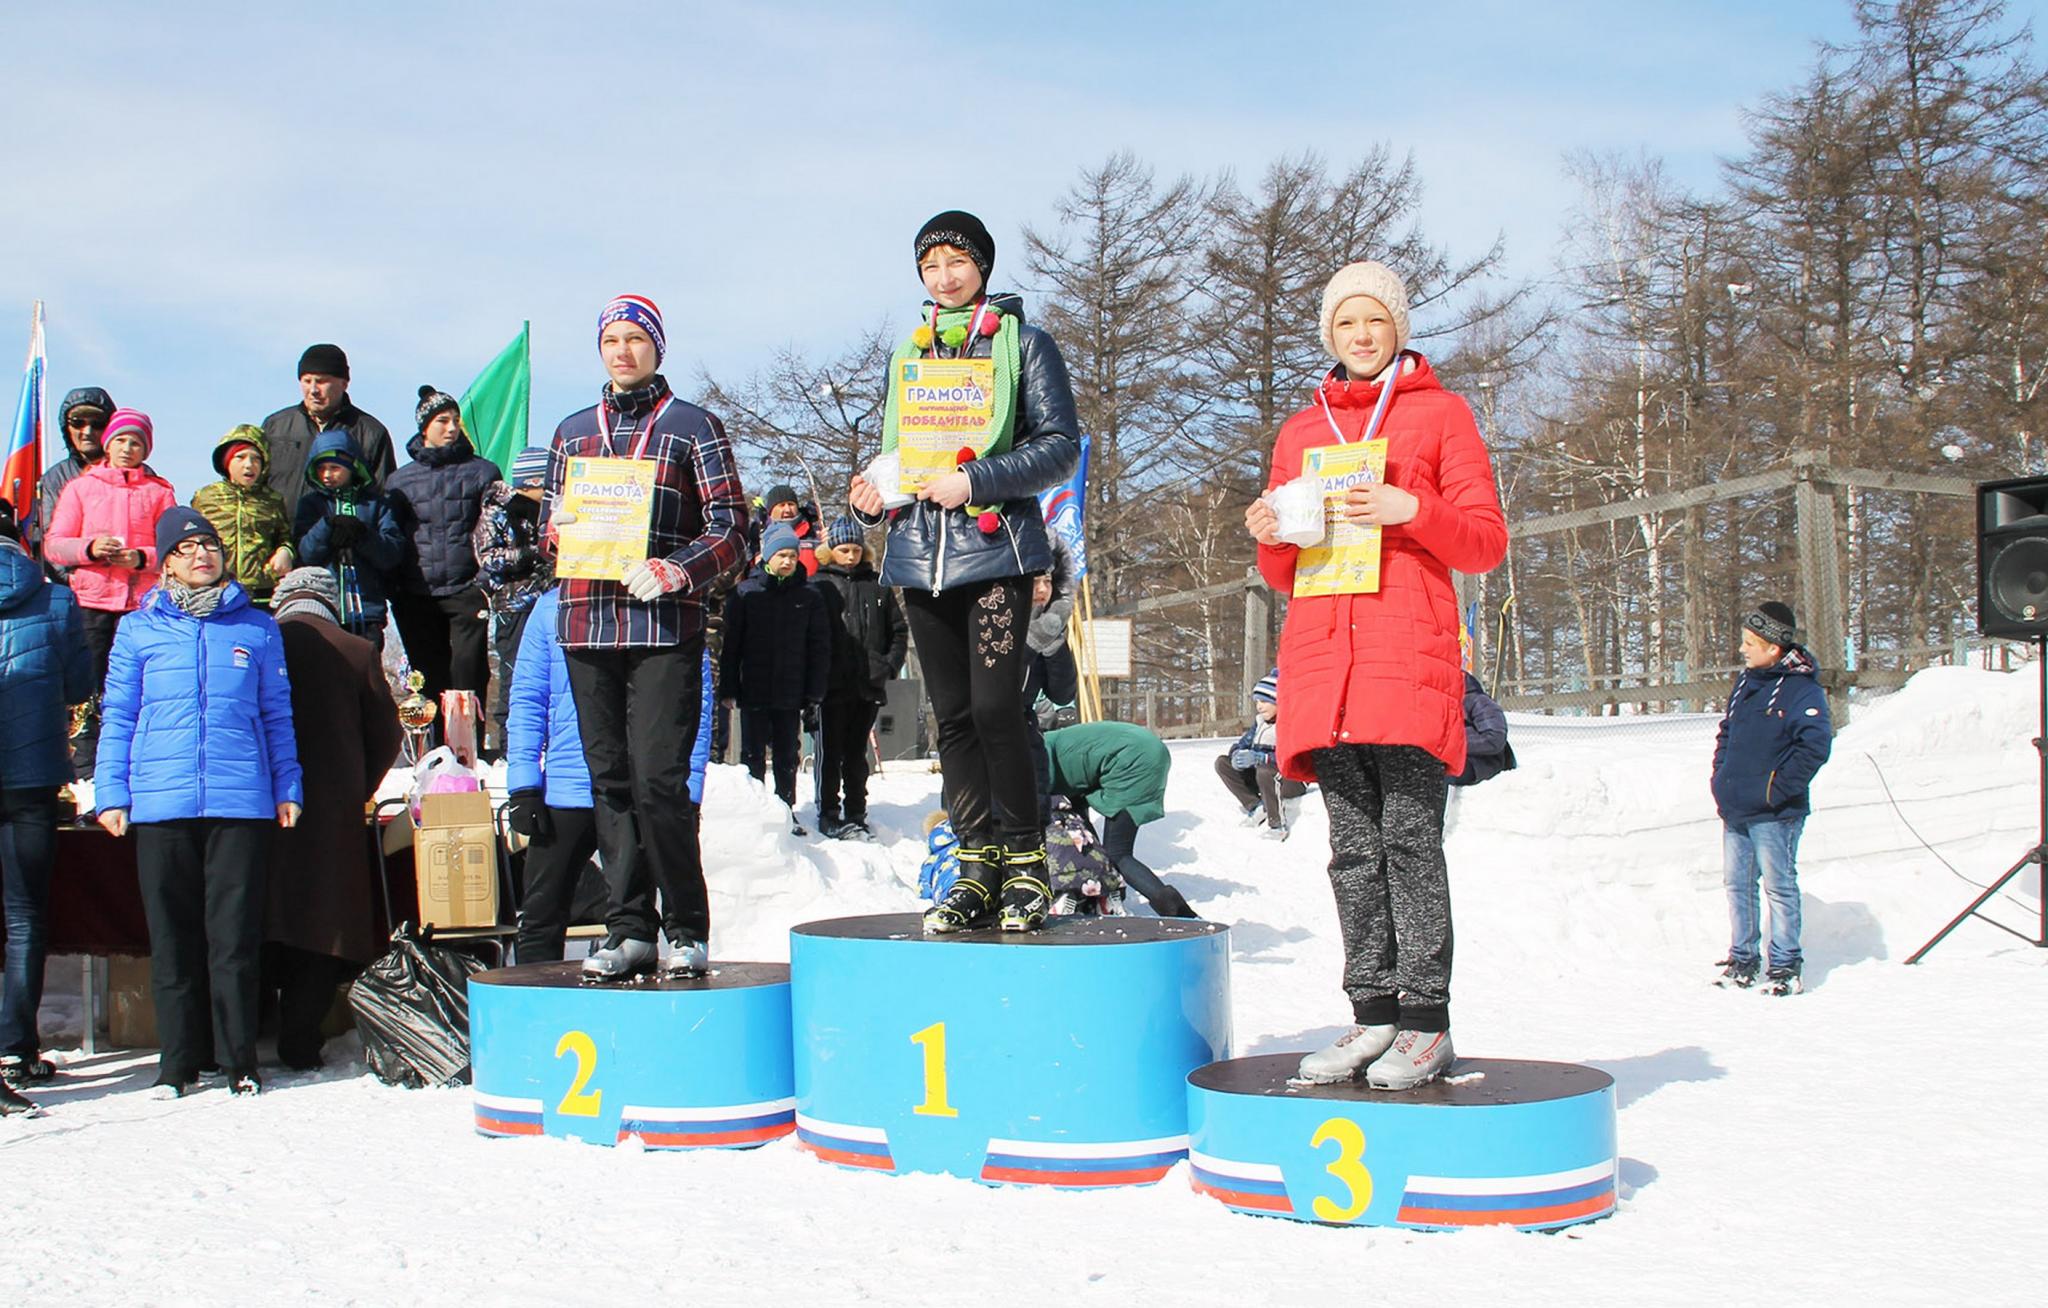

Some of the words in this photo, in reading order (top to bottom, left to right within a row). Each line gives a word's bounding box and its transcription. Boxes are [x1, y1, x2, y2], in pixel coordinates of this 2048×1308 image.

[908, 387, 983, 401] ГРАМОТА
[901, 415, 986, 427] ПОБЕДИТЕЛЬ
[573, 483, 643, 499] ГРАМОТА
[1321, 471, 1373, 491] АМОТА
[555, 1030, 602, 1118] 2
[909, 1022, 958, 1118] 1
[1310, 1118, 1373, 1222] 3
